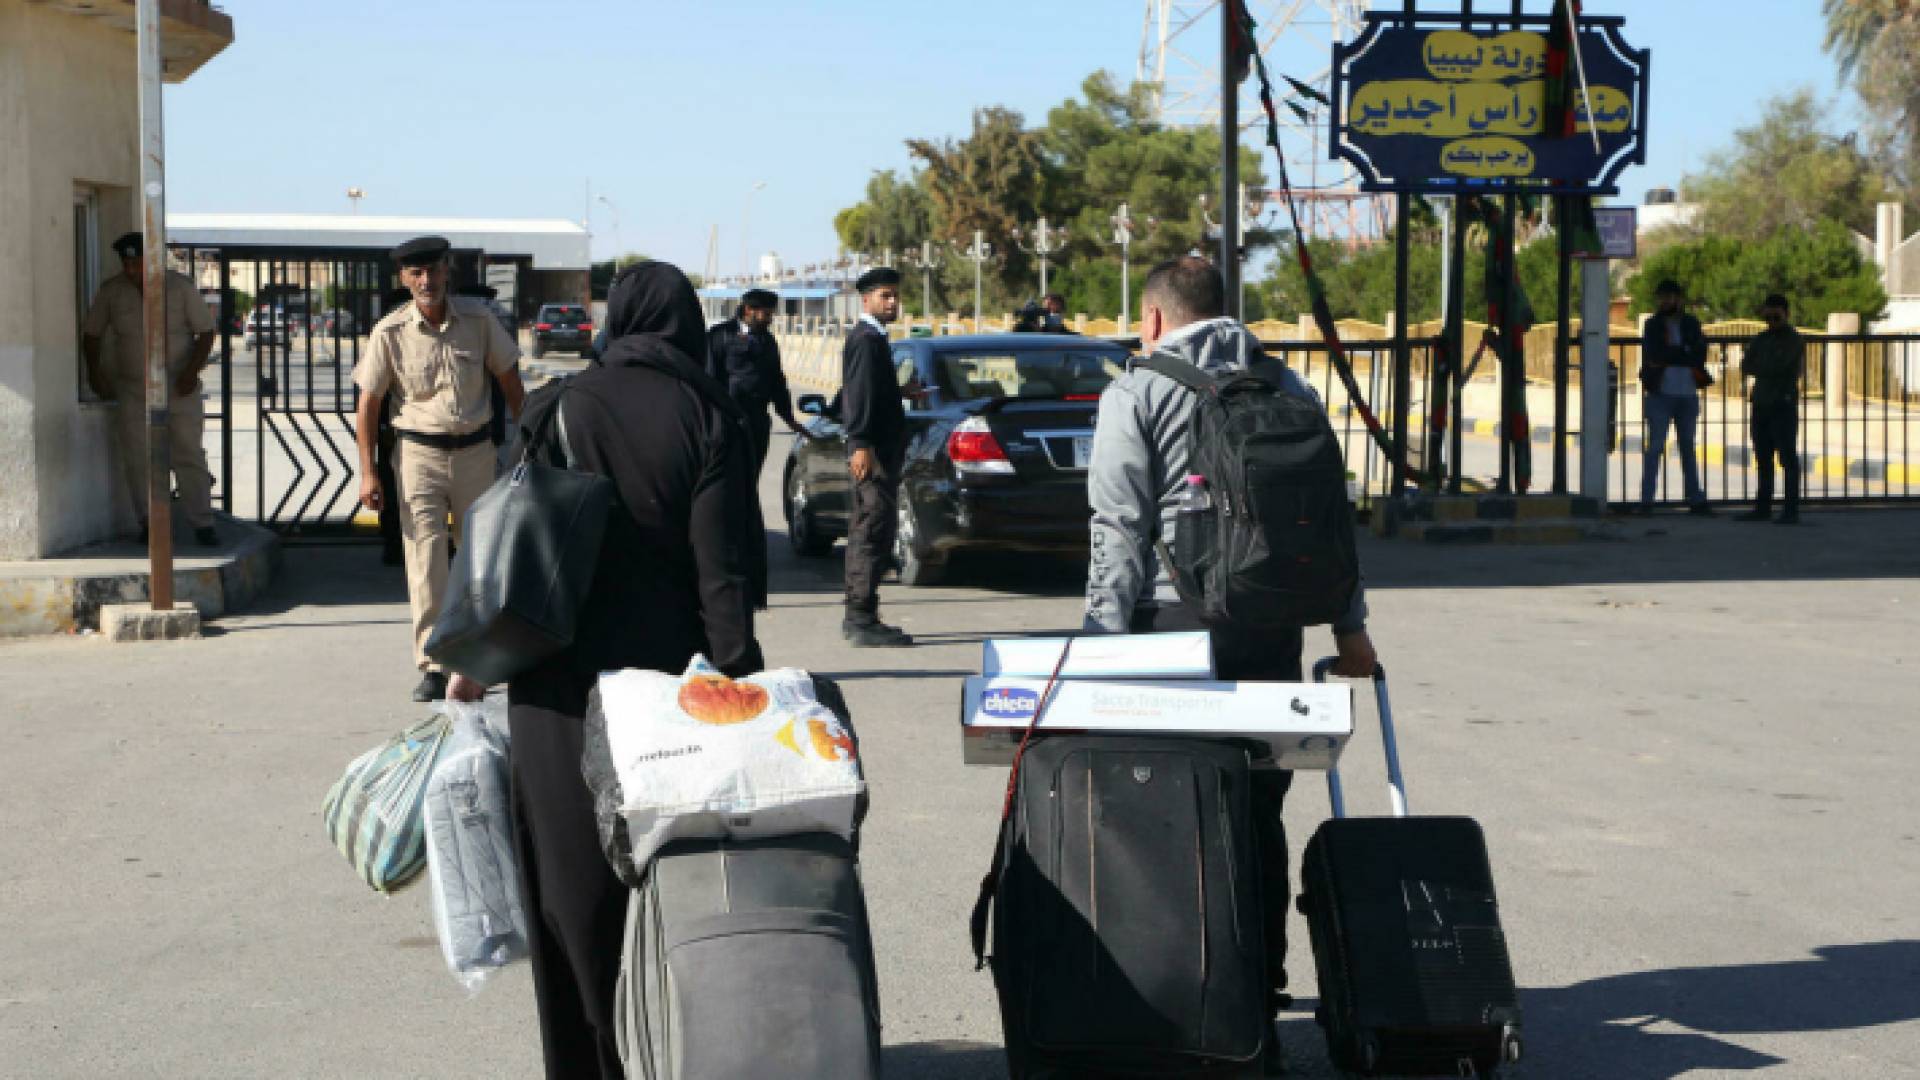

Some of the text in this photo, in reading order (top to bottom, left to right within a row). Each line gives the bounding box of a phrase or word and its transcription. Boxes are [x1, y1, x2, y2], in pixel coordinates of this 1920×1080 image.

[1428, 45, 1483, 73] ليبيا
[1349, 84, 1456, 128] أجدير
[1468, 86, 1537, 130] رأس
[1447, 145, 1529, 168] يرحب بكم
